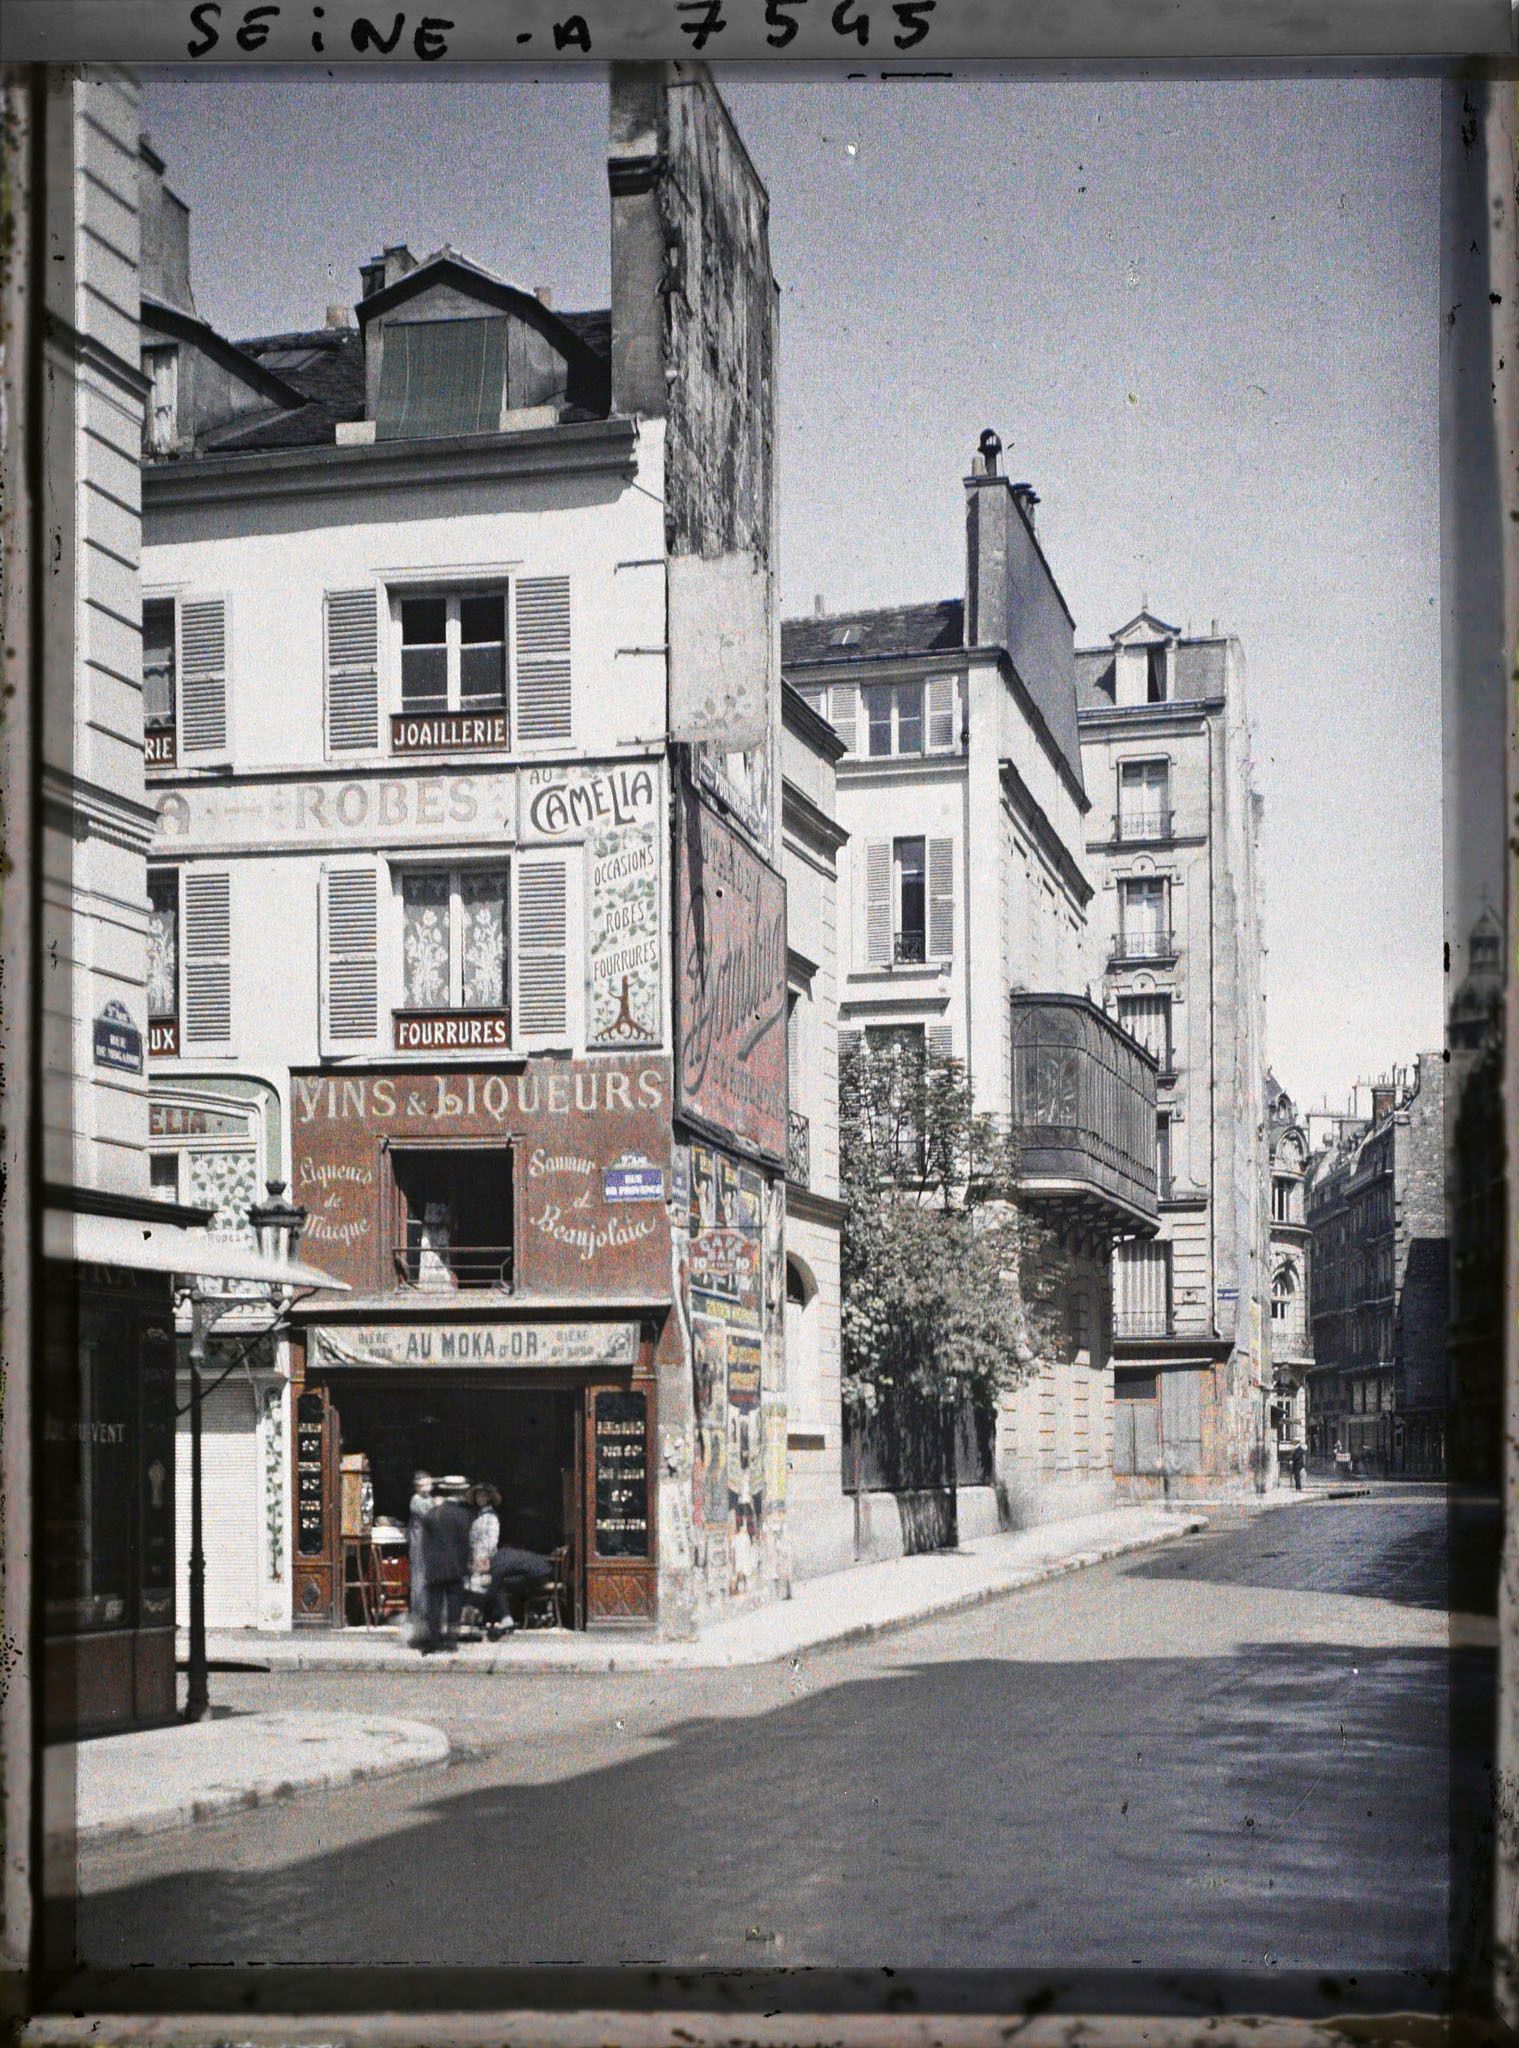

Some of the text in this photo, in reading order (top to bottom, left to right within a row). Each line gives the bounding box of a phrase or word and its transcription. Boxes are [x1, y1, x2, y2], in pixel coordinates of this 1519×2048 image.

[394, 719, 505, 746] JOAILLERIE
[529, 768, 552, 786] AU
[295, 778, 478, 830] ROBES
[530, 771, 653, 835] CAMÉLIA
[594, 844, 654, 887] OCCASIONS
[606, 901, 645, 933] ROBES
[593, 940, 656, 981] FOURRURES
[149, 1028, 175, 1051] UX
[399, 1020, 506, 1045] FOURRURES
[300, 1078, 396, 1122] VINS
[406, 1092, 426, 1116] &
[434, 1070, 663, 1121] LIQUEURS
[300, 1157, 372, 1188] Liqueurs
[529, 1148, 596, 1176] Saumur
[406, 1333, 432, 1358] AU
[442, 1332, 494, 1358] MOKA
